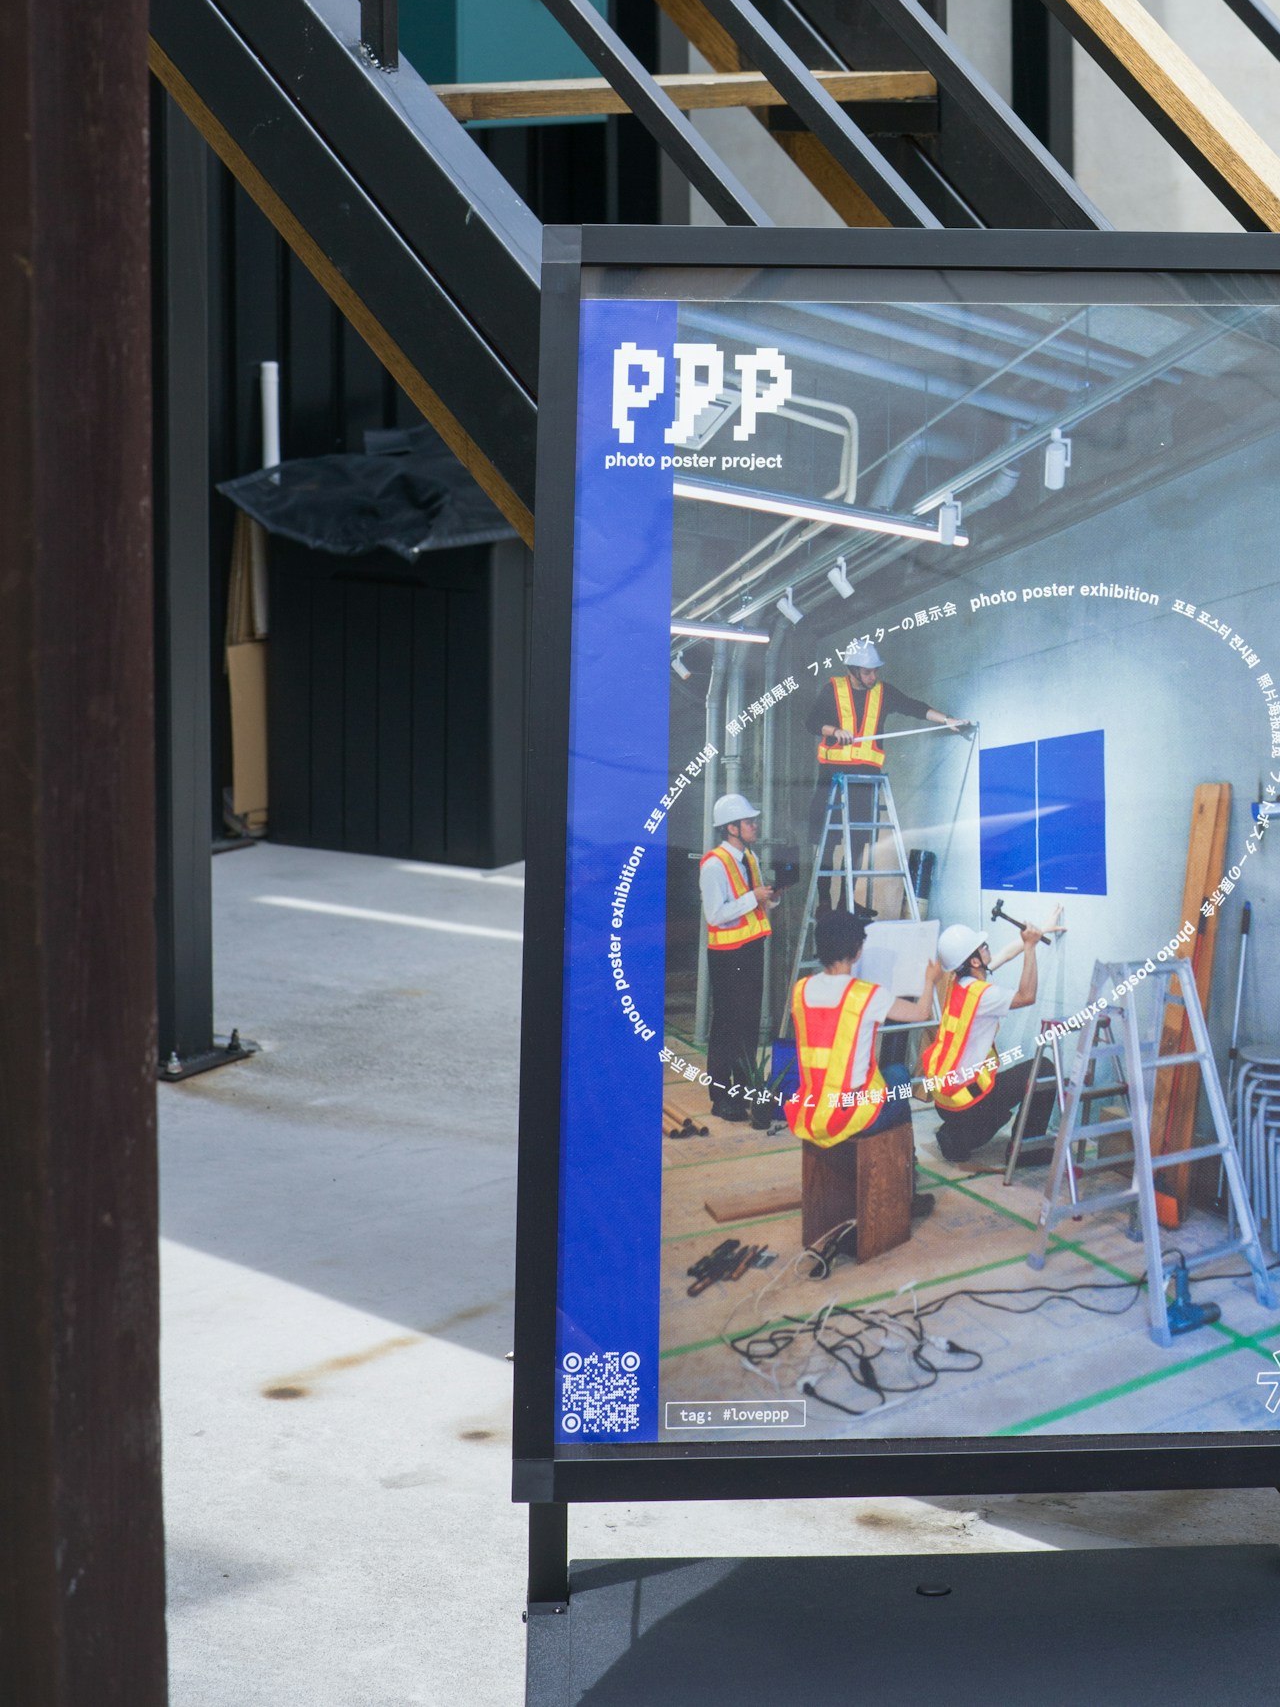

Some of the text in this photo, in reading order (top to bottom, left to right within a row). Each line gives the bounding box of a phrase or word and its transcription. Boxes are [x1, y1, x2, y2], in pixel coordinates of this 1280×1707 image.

[605, 452, 783, 471] photo poster project
[970, 582, 1160, 612] photo poster exhibition
[1171, 599, 1261, 669] 포토 포스터 전시회
[725, 675, 799, 738] 照片海报展览
[644, 743, 719, 834] 포토 포스터 전시회
[608, 845, 656, 1042] photo poster exhibition
[1035, 920, 1196, 1046] photo poster exhibition
[680, 1408, 789, 1424] tag: #loveppp
